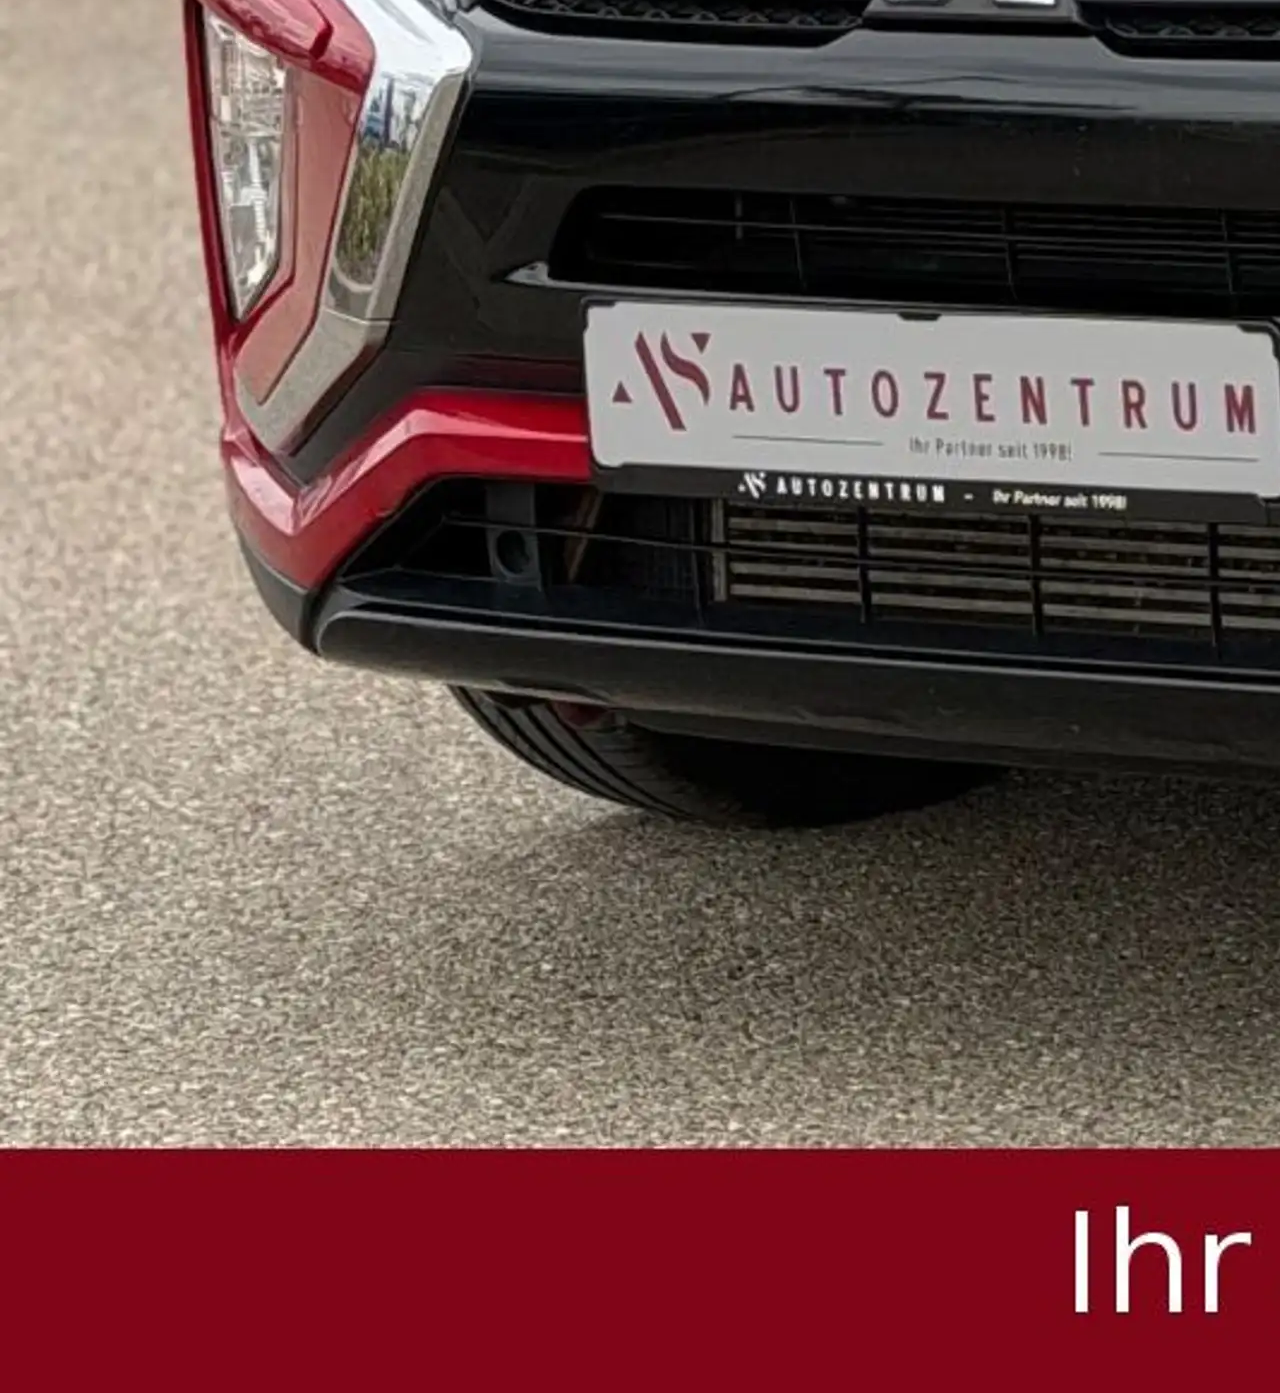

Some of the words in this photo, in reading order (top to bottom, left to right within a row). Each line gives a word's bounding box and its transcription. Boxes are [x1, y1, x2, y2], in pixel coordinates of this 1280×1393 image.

[729, 362, 1257, 435] AUTOZENTRUM
[909, 436, 930, 456] Ihr
[936, 437, 993, 459] Partner
[997, 441, 1028, 461] seit
[1033, 442, 1073, 463] 1998!
[776, 476, 946, 503] AUTOZENTRUM
[993, 489, 1010, 504] Ihr
[1013, 489, 1061, 508] Partner
[1064, 493, 1088, 509] seit
